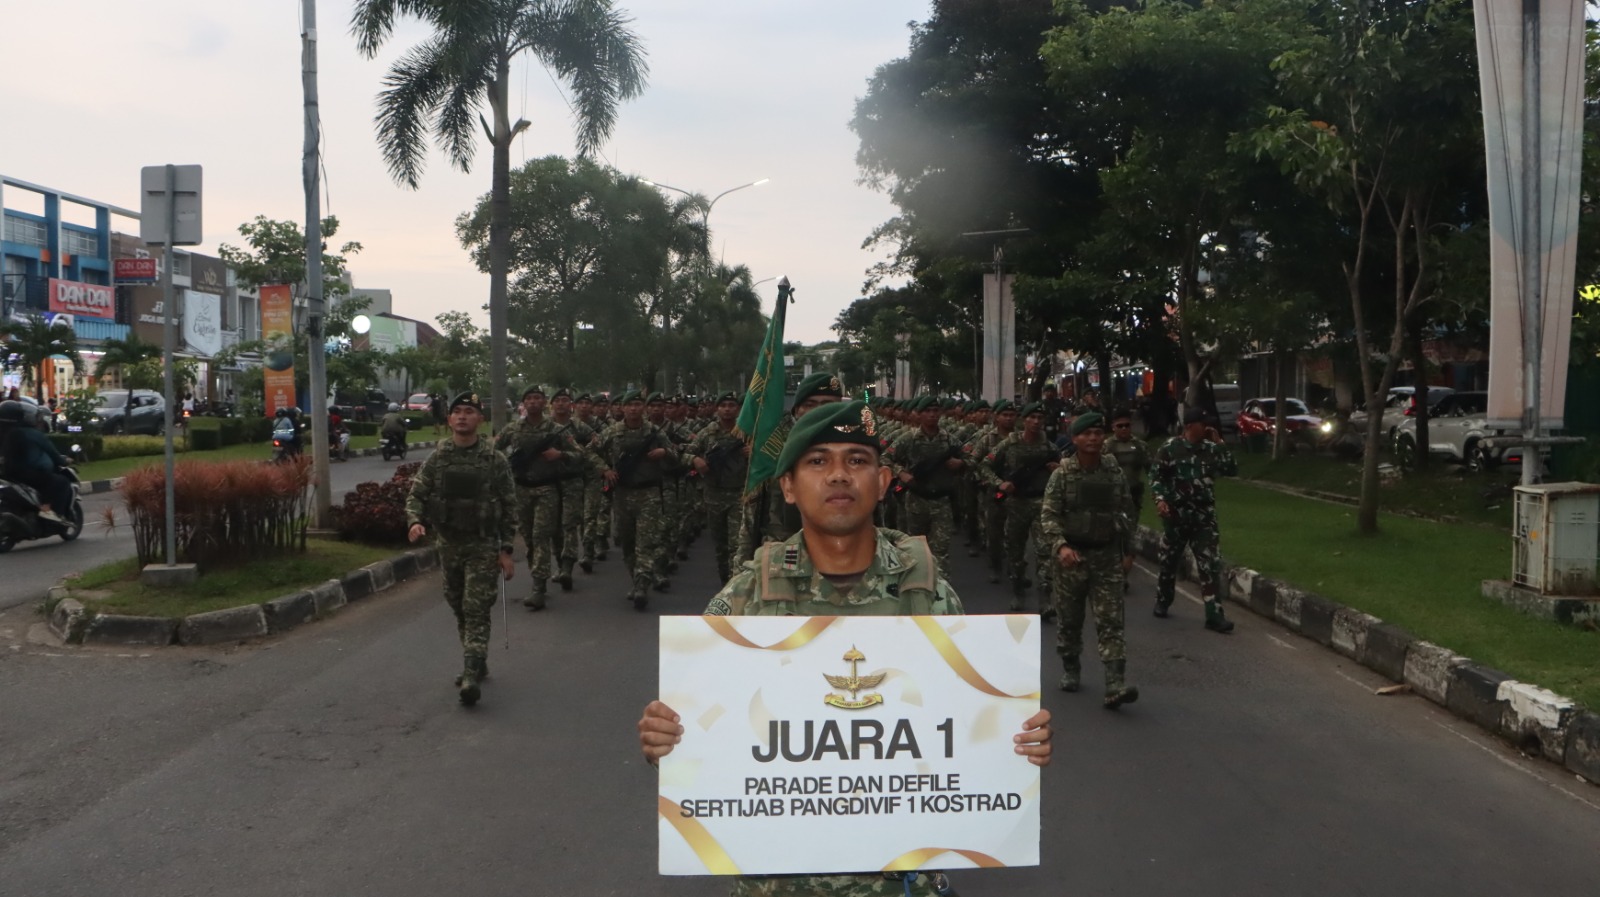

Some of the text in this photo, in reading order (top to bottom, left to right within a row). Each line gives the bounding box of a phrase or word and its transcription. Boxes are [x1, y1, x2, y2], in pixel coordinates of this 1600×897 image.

[118, 261, 154, 270] DAN DAN
[57, 283, 112, 307] DAN DAN
[751, 718, 954, 763] JUARA 1
[745, 774, 960, 795] PARADE DAN DEFILE
[680, 793, 1021, 818] SERTIJAB PANGDIVIF 1 KOSTRAD
